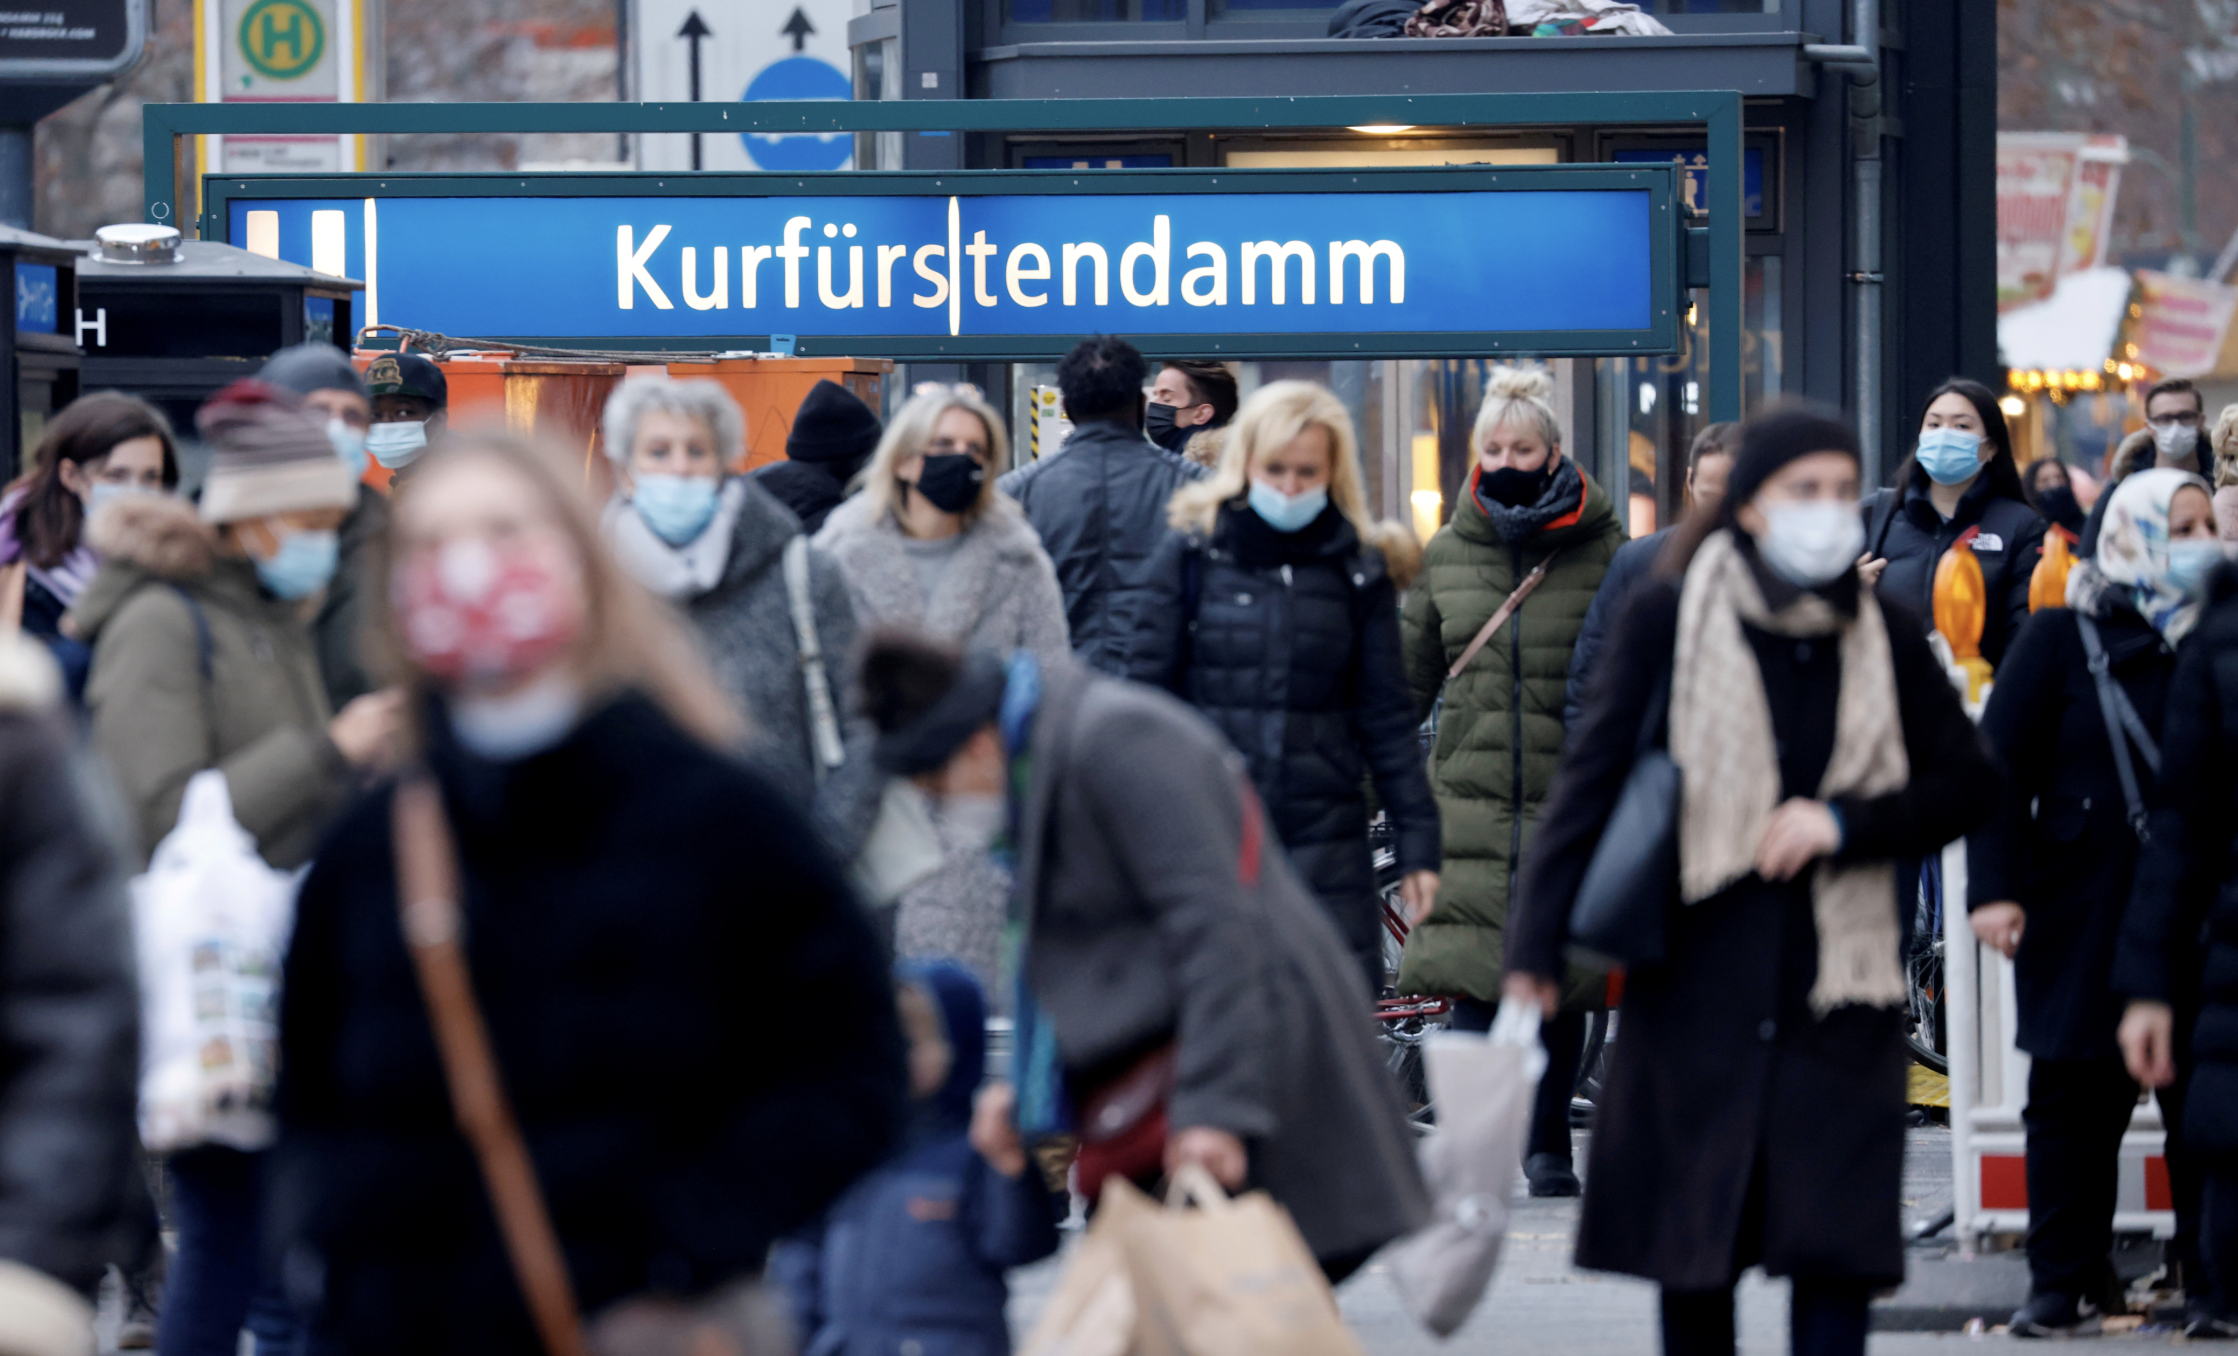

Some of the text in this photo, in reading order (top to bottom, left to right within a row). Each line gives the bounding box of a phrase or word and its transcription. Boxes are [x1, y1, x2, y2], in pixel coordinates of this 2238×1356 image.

[262, 14, 300, 59] H
[615, 214, 1404, 310] Kurfürstendamm
[75, 308, 107, 348] H
